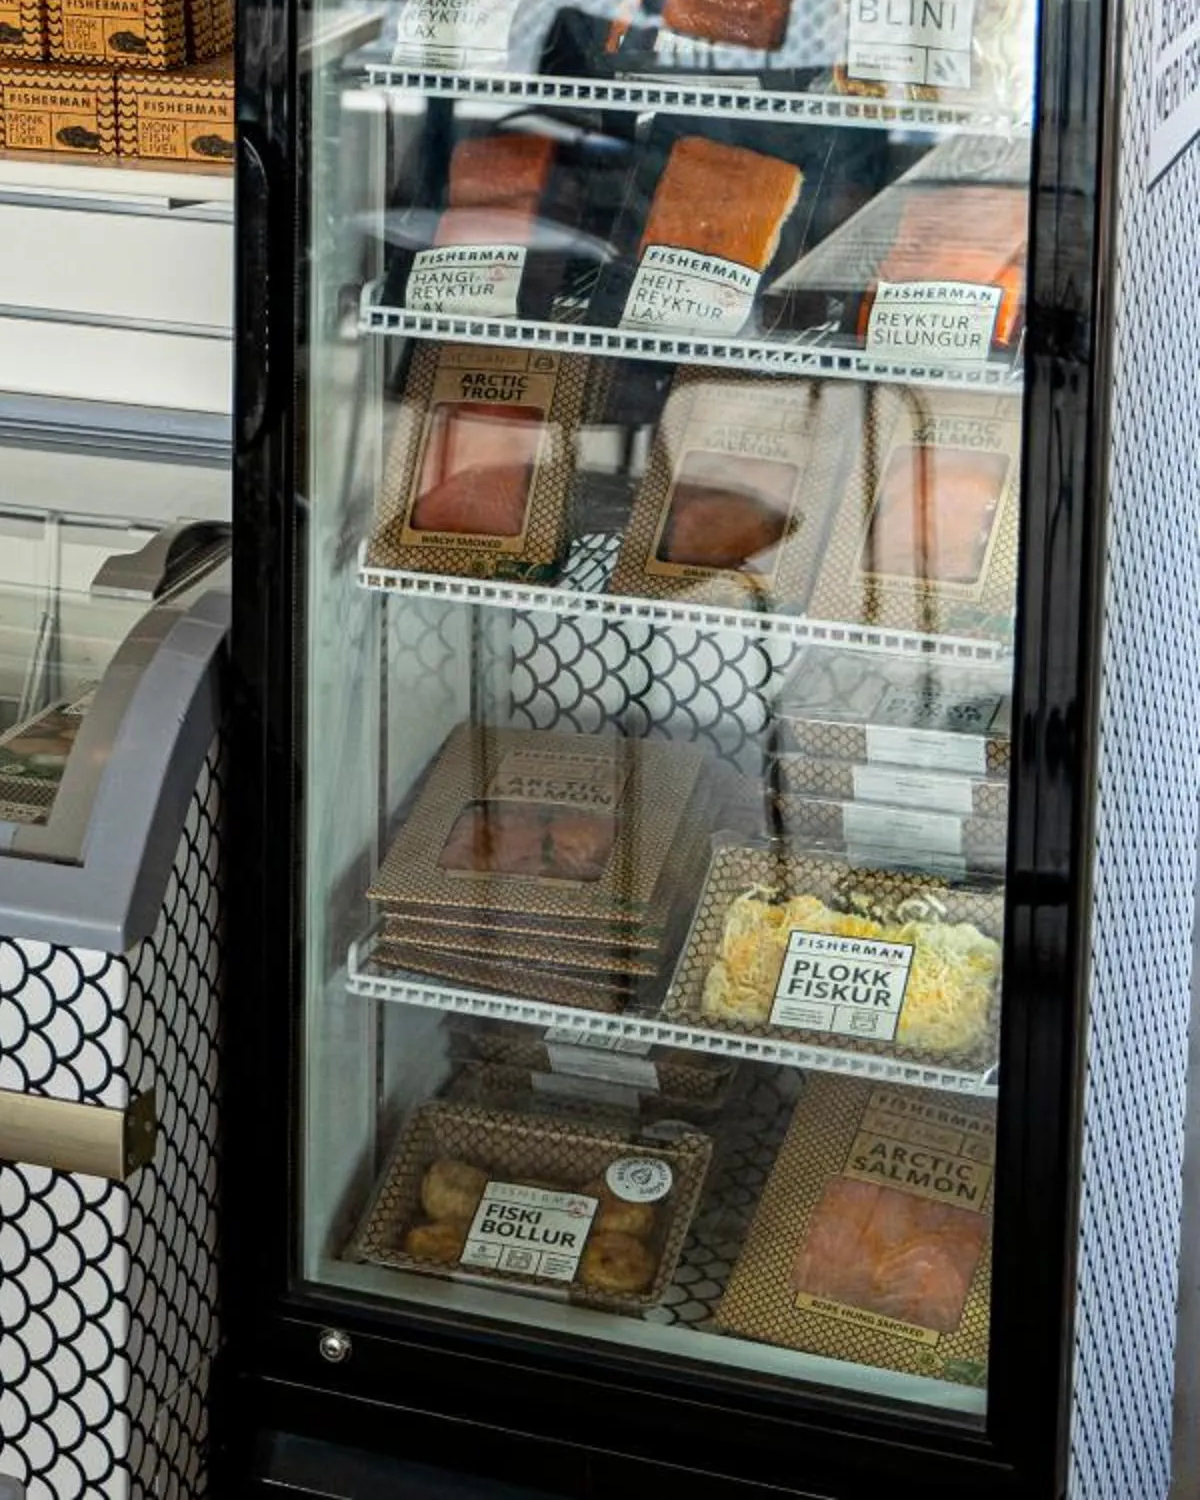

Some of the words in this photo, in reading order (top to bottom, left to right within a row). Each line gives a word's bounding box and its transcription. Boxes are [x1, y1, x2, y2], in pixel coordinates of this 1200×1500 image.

[66, 17, 97, 29] MONK
[9, 92, 91, 108] FISHERMAN
[143, 102, 228, 116] FISHERMAN
[9, 113, 44, 125] MONK
[142, 121, 178, 133] MONK
[420, 251, 519, 265] FISHERMAN
[412, 271, 479, 284] HANGI-
[649, 251, 751, 287] FISHERMAN
[411, 283, 495, 300] REYKTUR
[641, 273, 691, 294] HEIT-
[883, 287, 992, 301] FISHERMAN
[630, 303, 665, 322] LAX
[636, 287, 724, 320] REYKTUR
[876, 312, 969, 330] REYKTUR
[873, 329, 982, 348] SILUNGUR
[460, 373, 529, 389] ARCTIC
[461, 386, 525, 401] TROUT
[797, 937, 905, 959] FISHERMAN
[792, 959, 892, 989] PLOKK
[787, 977, 892, 1007] FISKUR
[869, 1142, 974, 1181] ARCTIC
[851, 1155, 978, 1201] SALMON
[485, 1202, 543, 1225] FISKI
[480, 1219, 577, 1249] BOLLUR
